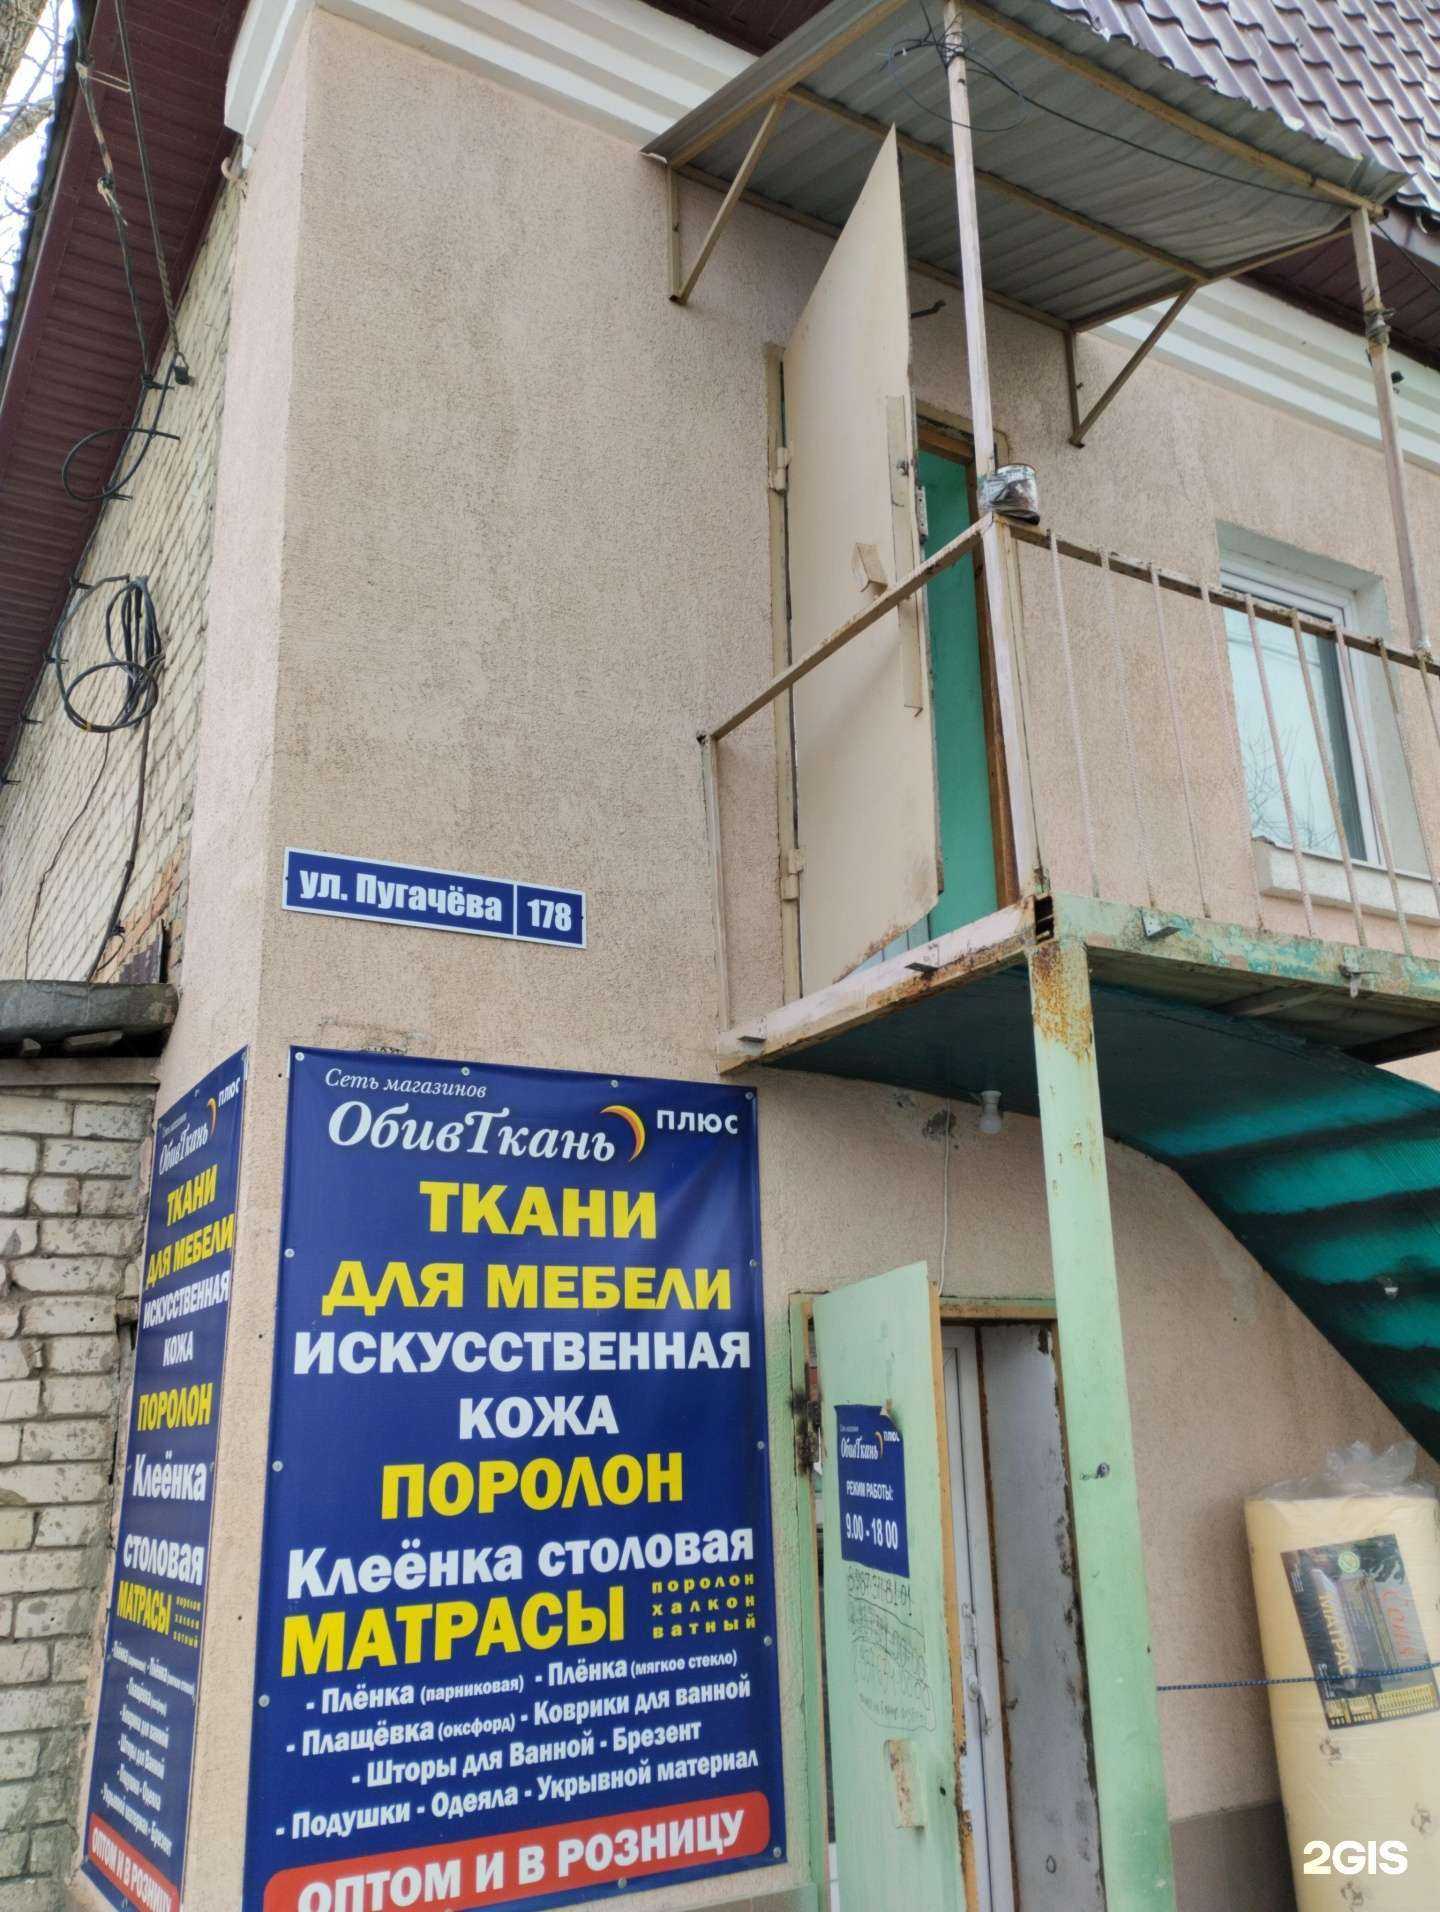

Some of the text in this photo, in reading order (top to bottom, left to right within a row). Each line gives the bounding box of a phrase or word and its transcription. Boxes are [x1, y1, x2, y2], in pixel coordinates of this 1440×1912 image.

[299, 870, 572, 932] ул. Пугачёва 178
[325, 1067, 487, 1099] Сеть магазинов
[327, 1100, 616, 1162] ОбивТкань
[166, 1163, 218, 1227] ТКАНИ
[419, 1180, 657, 1239] ТКАНИ
[145, 1213, 235, 1291] ДЛЯ МЕБЕЛИ
[143, 1270, 230, 1329] ИСКУССТВЕННАЯ
[321, 1260, 731, 1316] ДЛЯ МЕБЕЛИ
[162, 1331, 194, 1367] КОЖА
[293, 1331, 751, 1375] ИСКУССТВЕННАЯ
[137, 1382, 213, 1432] ПОРОЛОН
[459, 1394, 620, 1440] КОЖА
[132, 1450, 208, 1502] Клеёнка
[380, 1452, 684, 1520] ПОРОЛОН
[846, 1480, 866, 1497] РЕЖИМ
[845, 1512, 864, 1542] 9.00
[123, 1533, 205, 1586] столовая
[287, 1527, 754, 1600] Клеёнка столовая
[651, 1573, 756, 1595] поролон
[116, 1580, 172, 1636] МАТРАСЫ
[280, 1585, 624, 1678] МАТРАСЫ
[651, 1594, 756, 1617] халкон
[651, 1614, 757, 1640] ватный
[321, 1649, 738, 1714] Плёнка (парниковая) Плёнка (мягкое стекло)
[302, 1673, 751, 1757] Плащёвка (оксфорд) Коврики для ванной
[366, 1720, 702, 1788] Шторы для Ванной Брезент
[291, 1749, 759, 1841] Подушки Одеяла Укрывной материал
[299, 1809, 745, 1912] ОПТОМ И В РОЗНИЦУ
